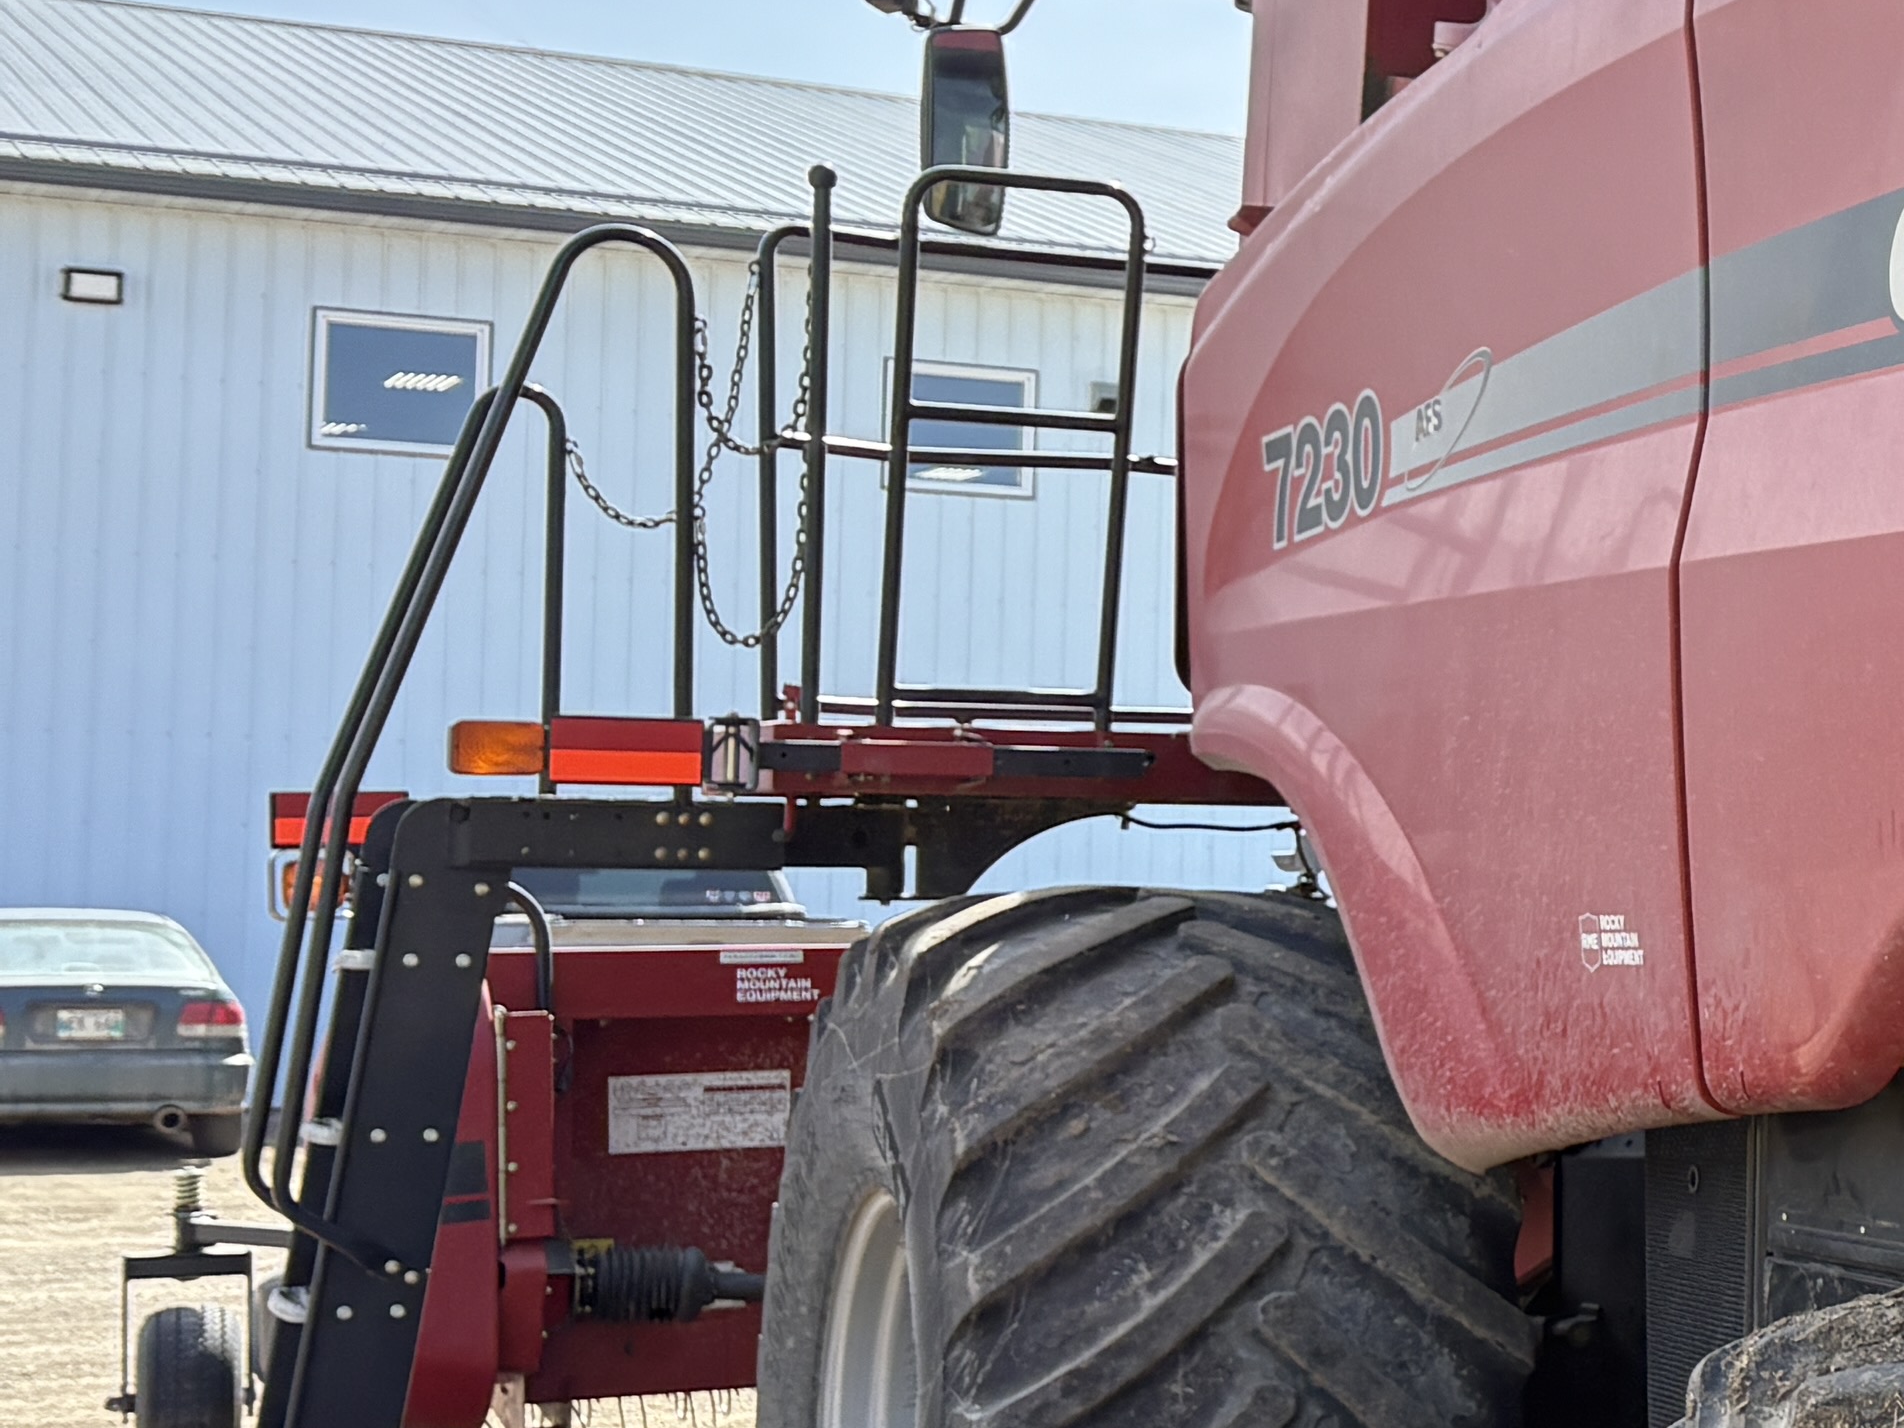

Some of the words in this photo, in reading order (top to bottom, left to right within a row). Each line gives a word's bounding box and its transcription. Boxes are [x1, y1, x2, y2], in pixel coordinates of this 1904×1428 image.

[1415, 399, 1443, 442] AFS
[1262, 388, 1384, 550] 7230
[736, 967, 787, 979] ROCKY
[736, 978, 812, 990] MOUNTAIN
[736, 989, 820, 1003] EQUIPMENT
